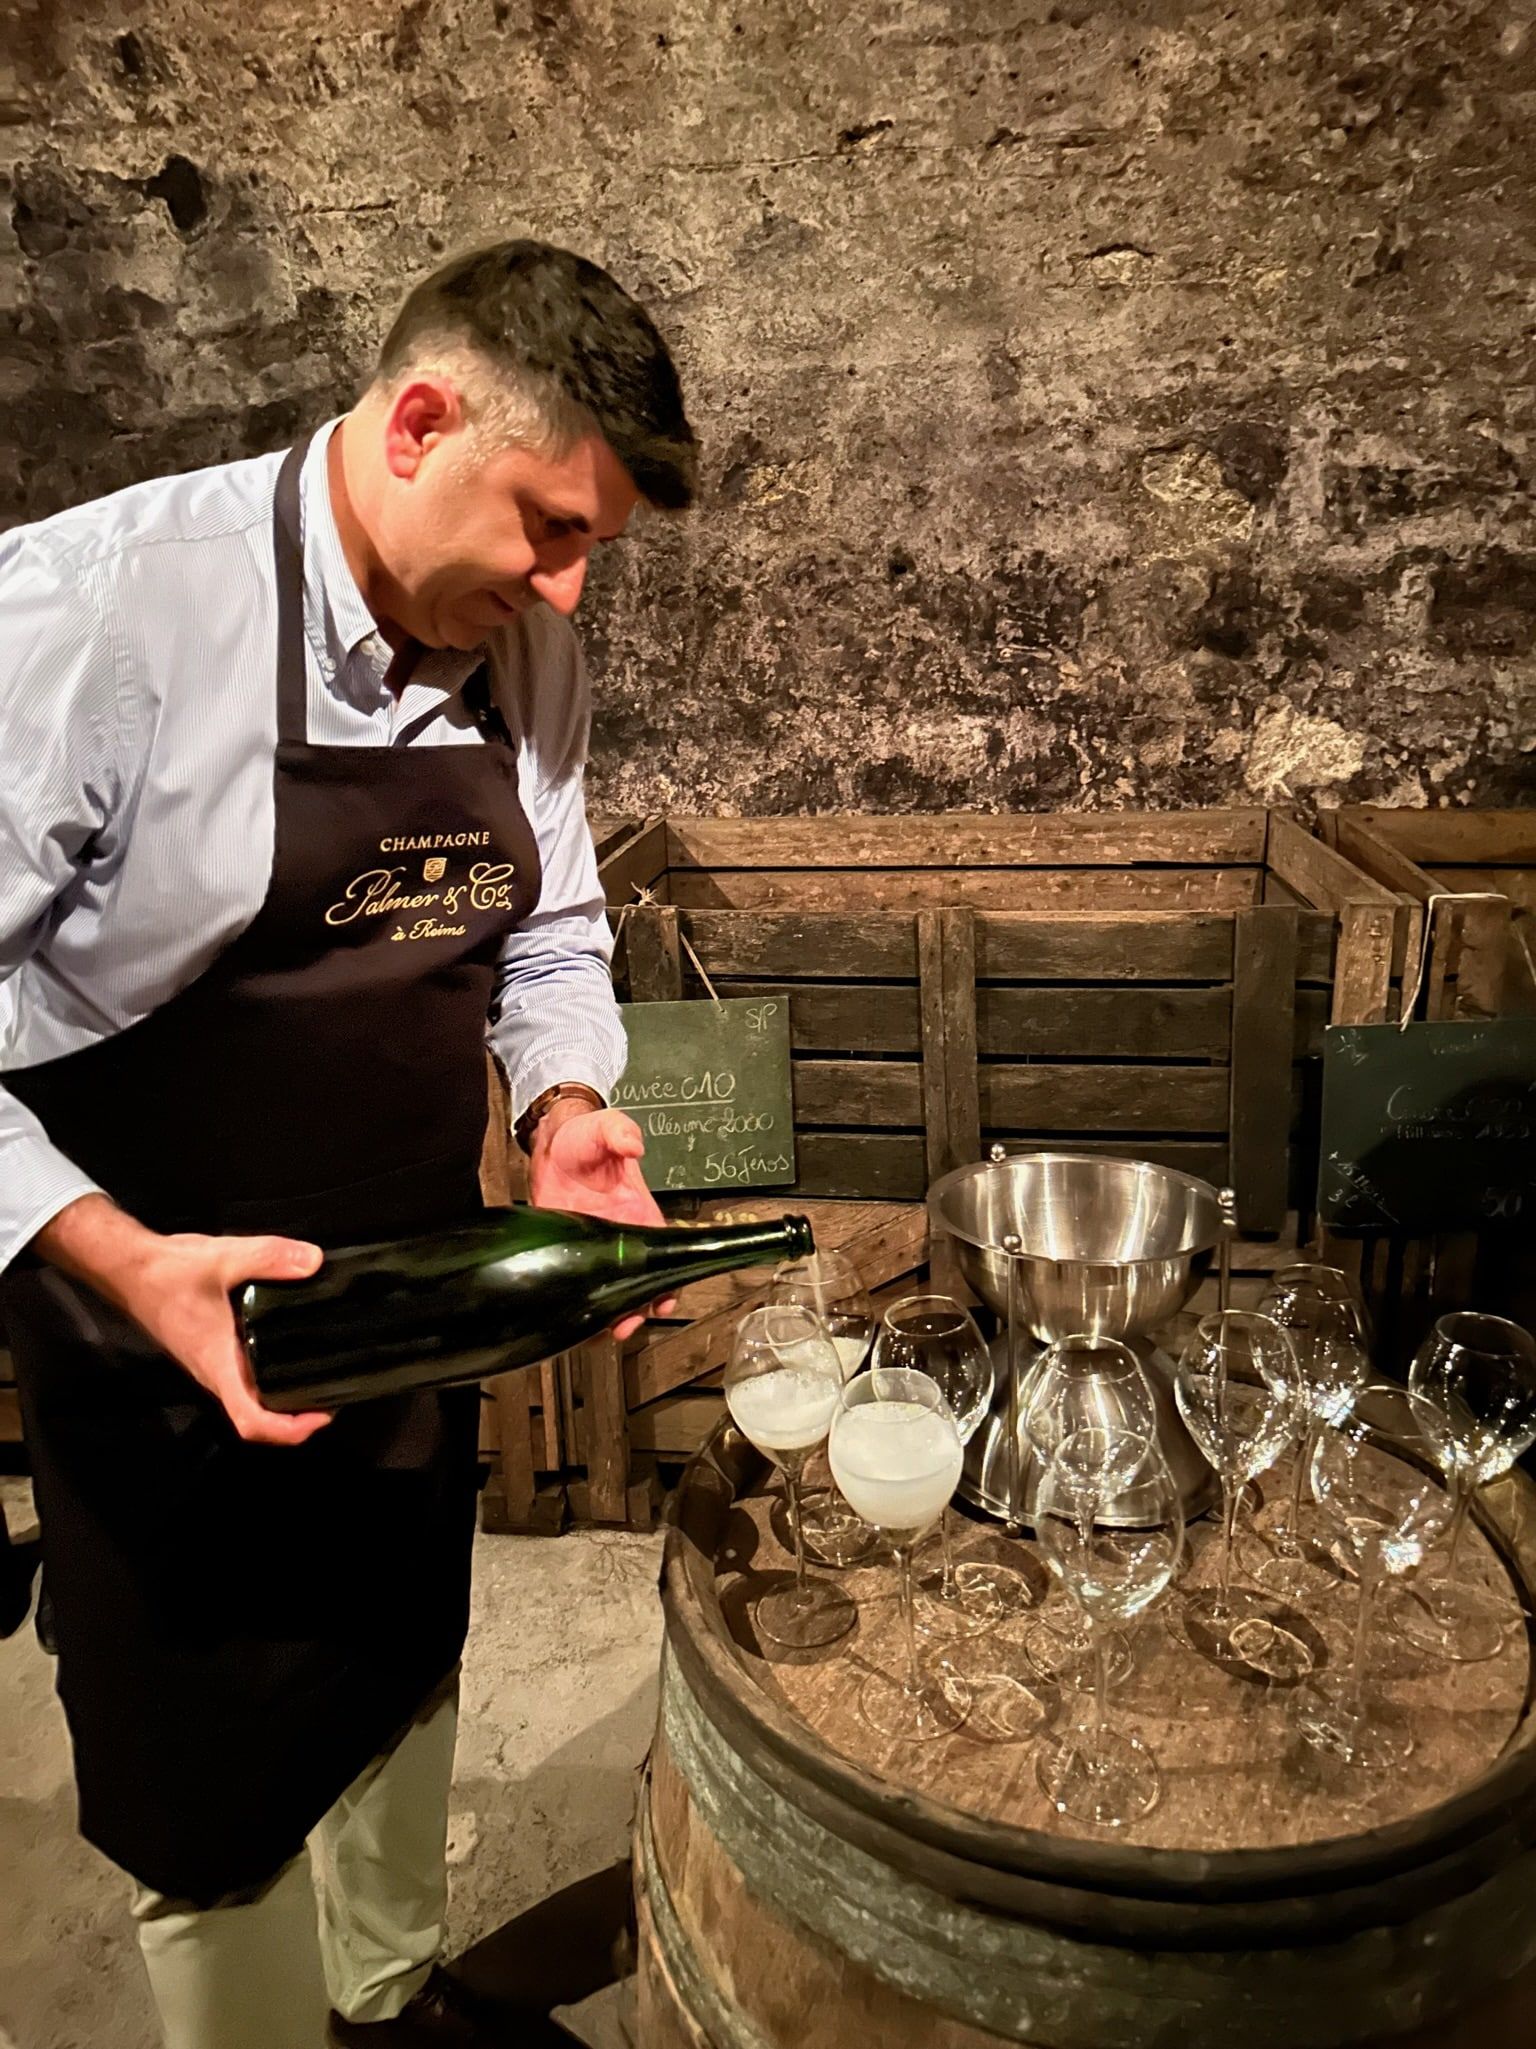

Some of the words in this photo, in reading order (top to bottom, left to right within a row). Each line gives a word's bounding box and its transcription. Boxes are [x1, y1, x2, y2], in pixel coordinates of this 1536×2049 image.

[380, 831, 490, 852] CHAMPAGNE
[325, 866, 440, 925] Palmer
[443, 885, 467, 915] &
[391, 926, 406, 941] à
[409, 918, 466, 940] Reims
[644, 1111, 715, 1137] llésime
[703, 1152, 737, 1183] 56
